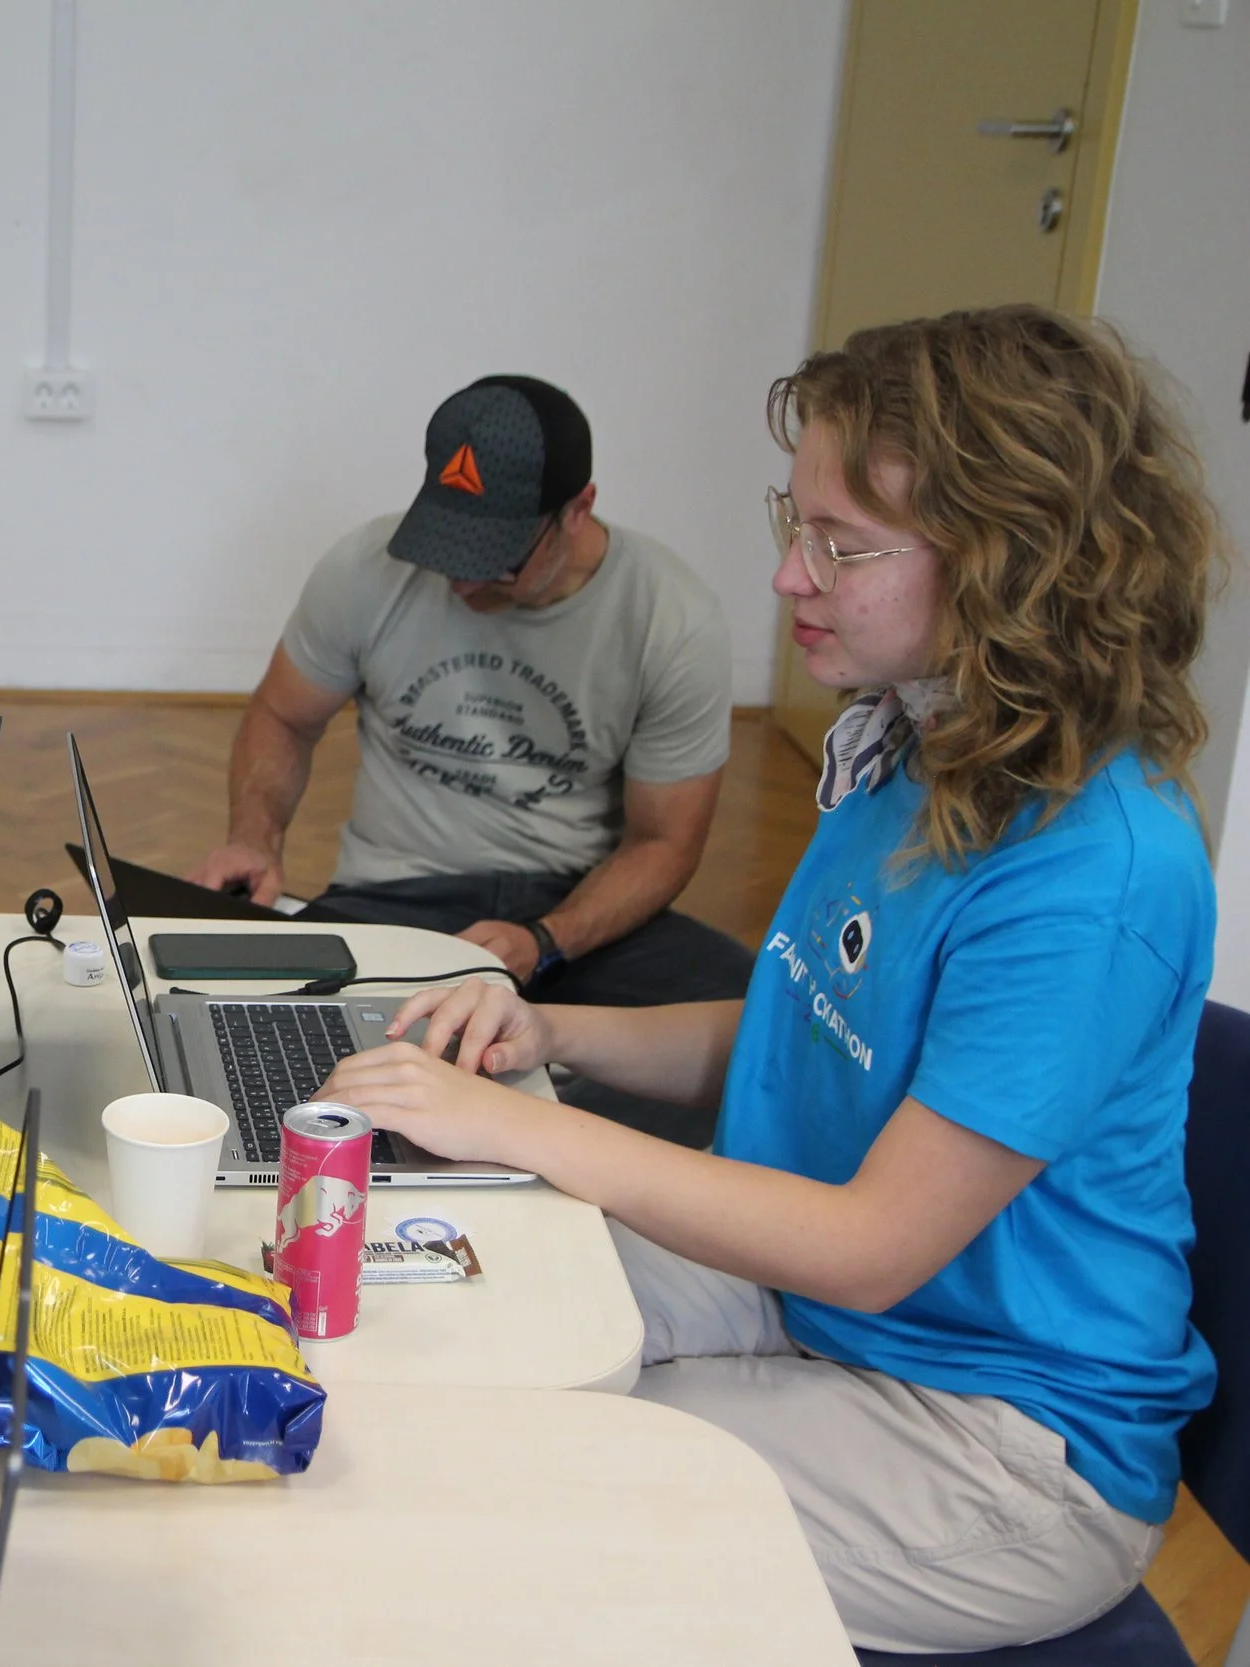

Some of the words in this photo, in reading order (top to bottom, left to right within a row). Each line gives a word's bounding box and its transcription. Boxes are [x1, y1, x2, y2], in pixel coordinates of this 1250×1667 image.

[392, 713, 495, 757] Authentic
[501, 734, 589, 773] Denim
[510, 658, 589, 752] TRADEMARK
[809, 976, 873, 1071] HCKATHON
